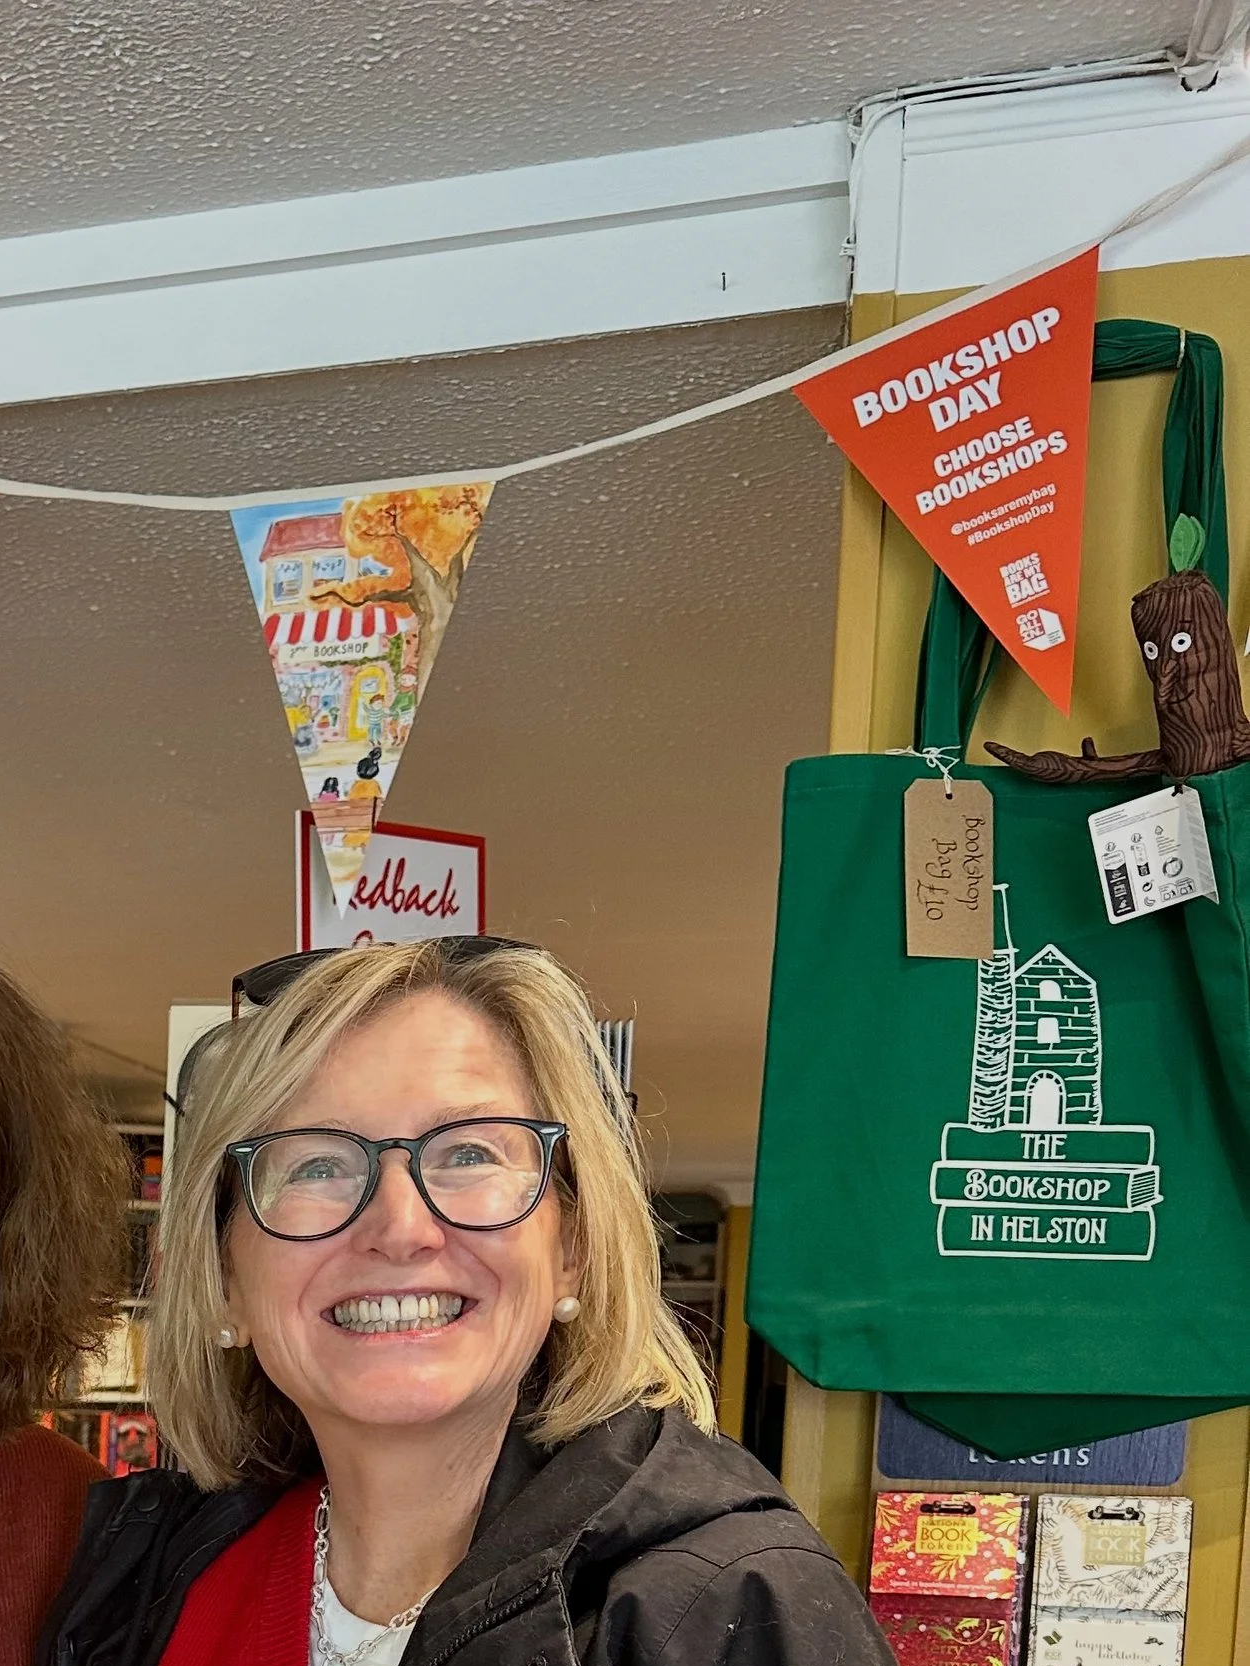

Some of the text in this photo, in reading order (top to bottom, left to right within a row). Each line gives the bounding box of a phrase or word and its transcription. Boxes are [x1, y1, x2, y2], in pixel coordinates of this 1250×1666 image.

[853, 307, 1061, 428] BOOKSHOP
[928, 371, 1002, 433] DAY
[934, 416, 1035, 477] CHOOSE
[915, 431, 1069, 515] BOOKSHOPS
[951, 484, 1057, 535] @booksaremybag
[967, 501, 1055, 546] #BookshopDay
[999, 552, 1039, 578] BOOKS
[1024, 563, 1042, 578] MY
[1005, 573, 1049, 604] BAG
[1016, 609, 1038, 625] GO
[313, 642, 369, 657] BOOKSHOP
[348, 857, 460, 919] edback
[916, 837, 957, 921] Bag £10
[1021, 1133, 1068, 1160] THE
[970, 1214, 1108, 1244] IN HELSTON
[920, 1528, 971, 1542] BOOK
[931, 1644, 965, 1660] erry
